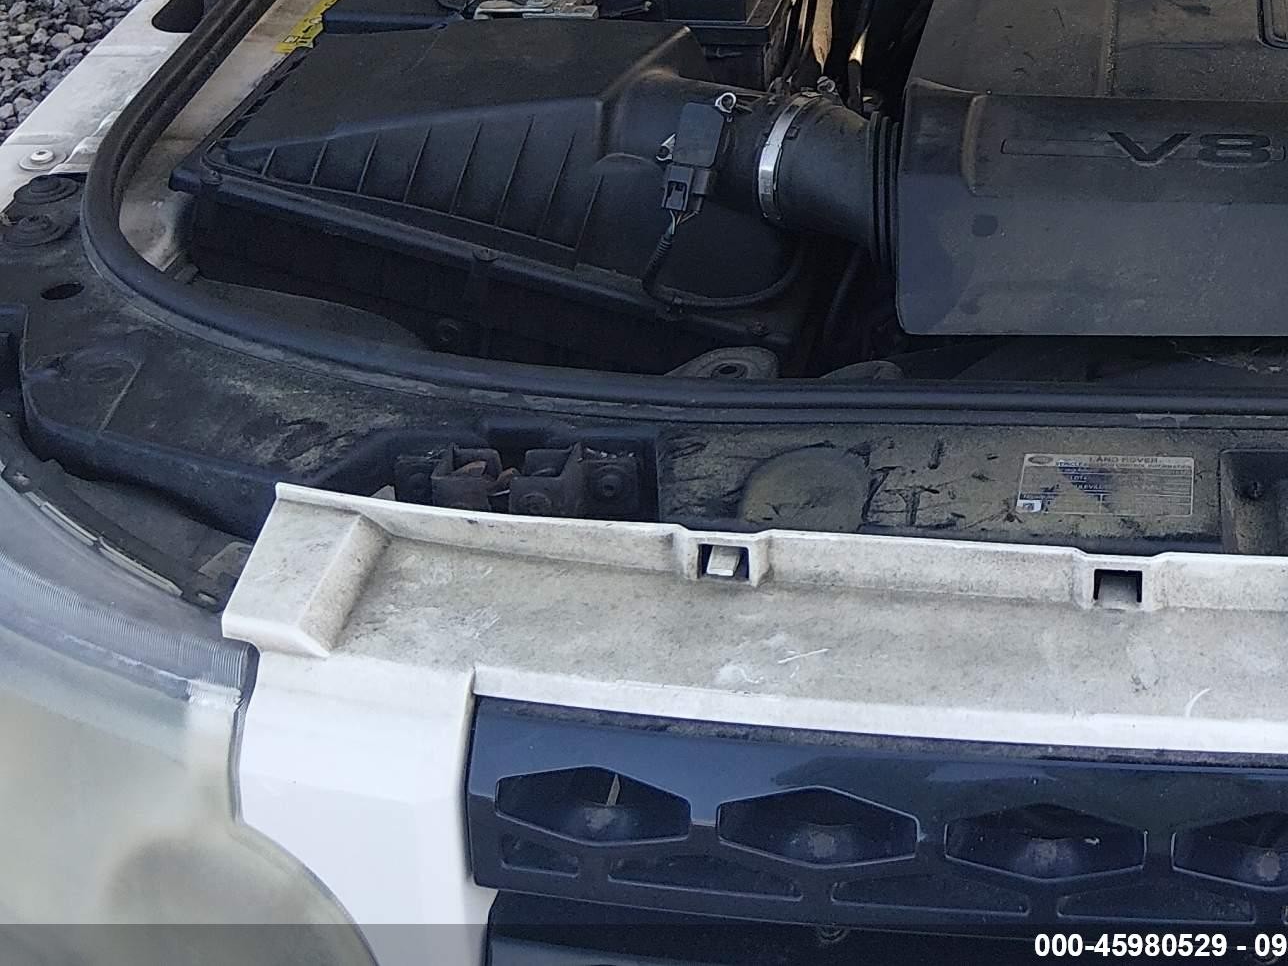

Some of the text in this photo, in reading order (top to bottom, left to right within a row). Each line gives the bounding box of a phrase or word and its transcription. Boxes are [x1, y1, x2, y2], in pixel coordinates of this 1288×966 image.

[1107, 131, 1271, 167] V8
[1089, 456, 1158, 464] LAND ROVER
